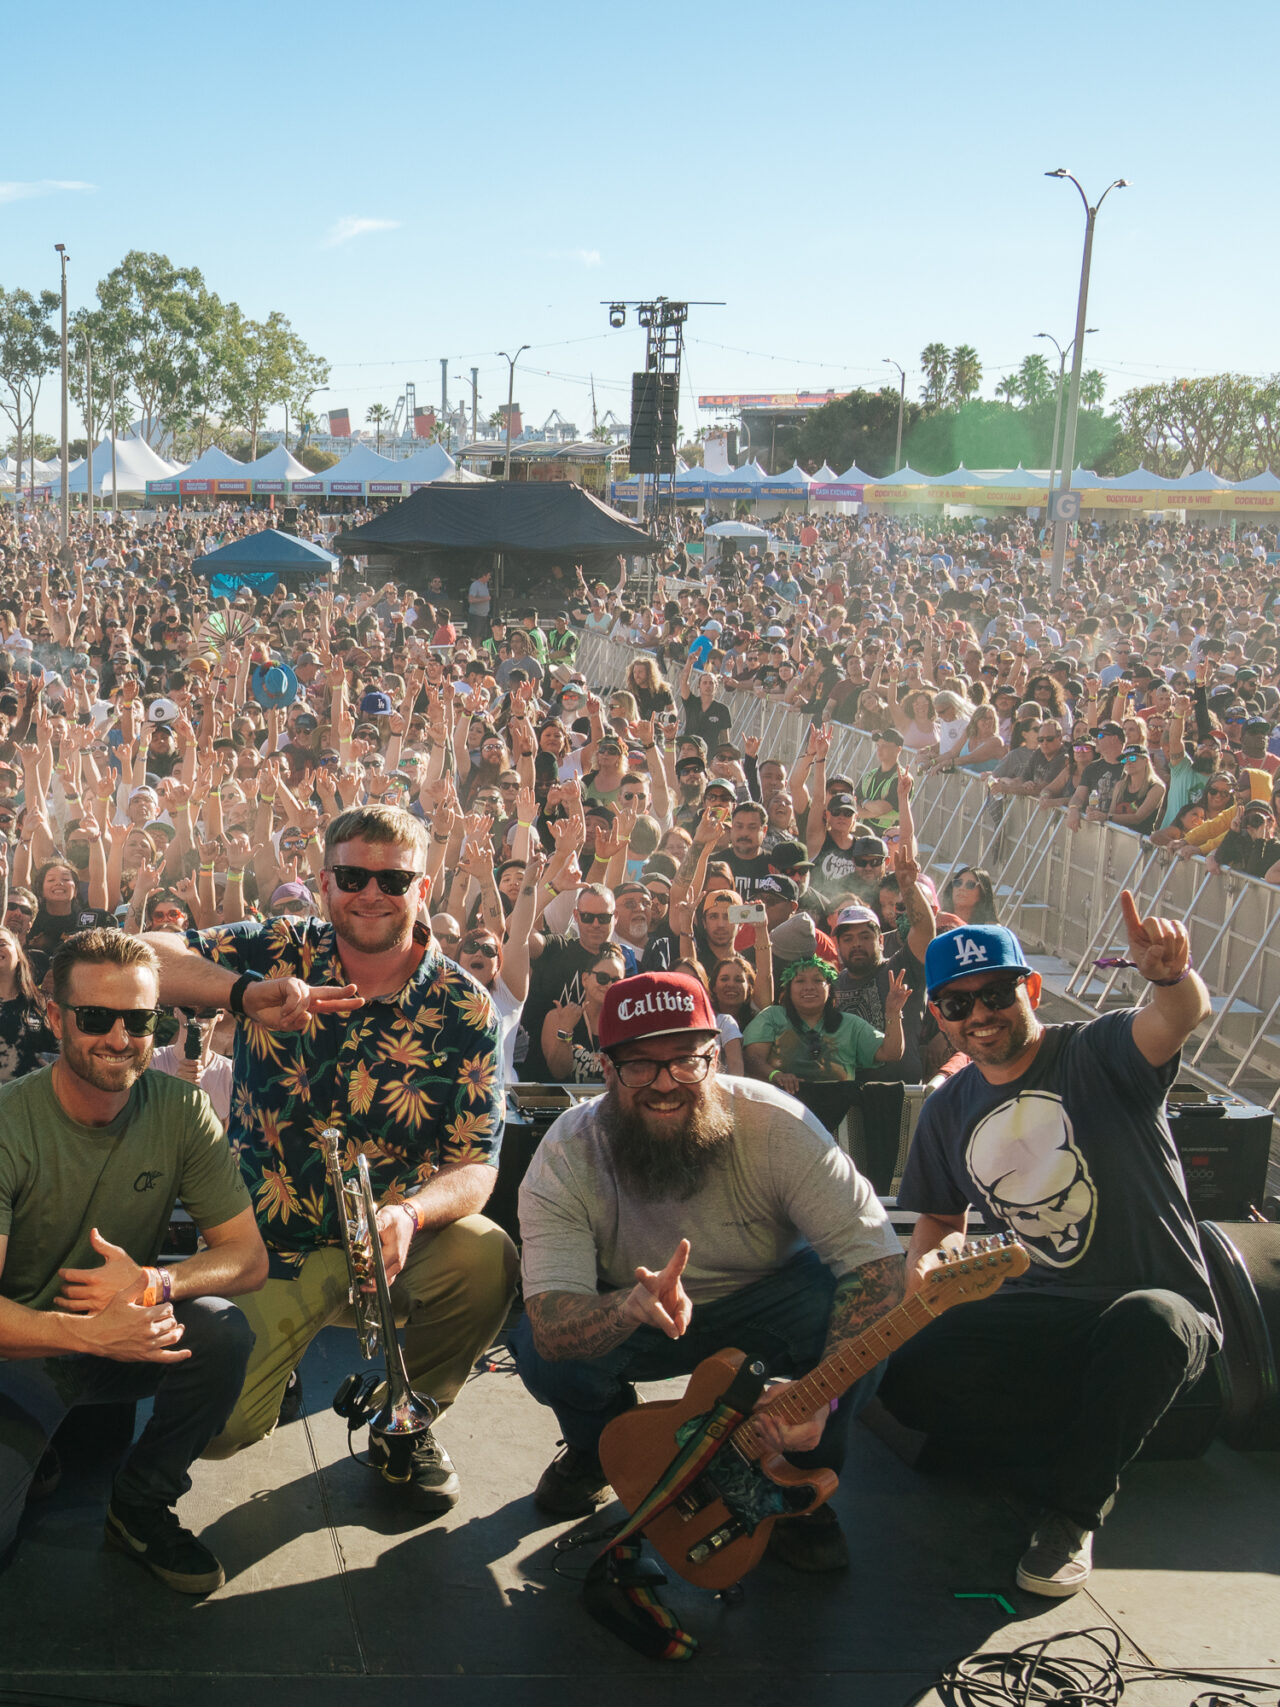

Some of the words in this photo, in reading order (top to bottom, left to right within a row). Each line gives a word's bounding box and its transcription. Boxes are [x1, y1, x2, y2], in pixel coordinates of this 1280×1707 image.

[815, 488, 829, 496] CASH
[830, 488, 857, 497] EXCHANGE
[1106, 494, 1144, 503] COCKTAILS
[1168, 495, 1186, 504] BEER
[1196, 496, 1212, 505] WINE
[1234, 496, 1274, 506] COCKTAILS
[1056, 494, 1077, 519] G
[953, 934, 989, 966] LA
[617, 990, 696, 1021] Calibis
